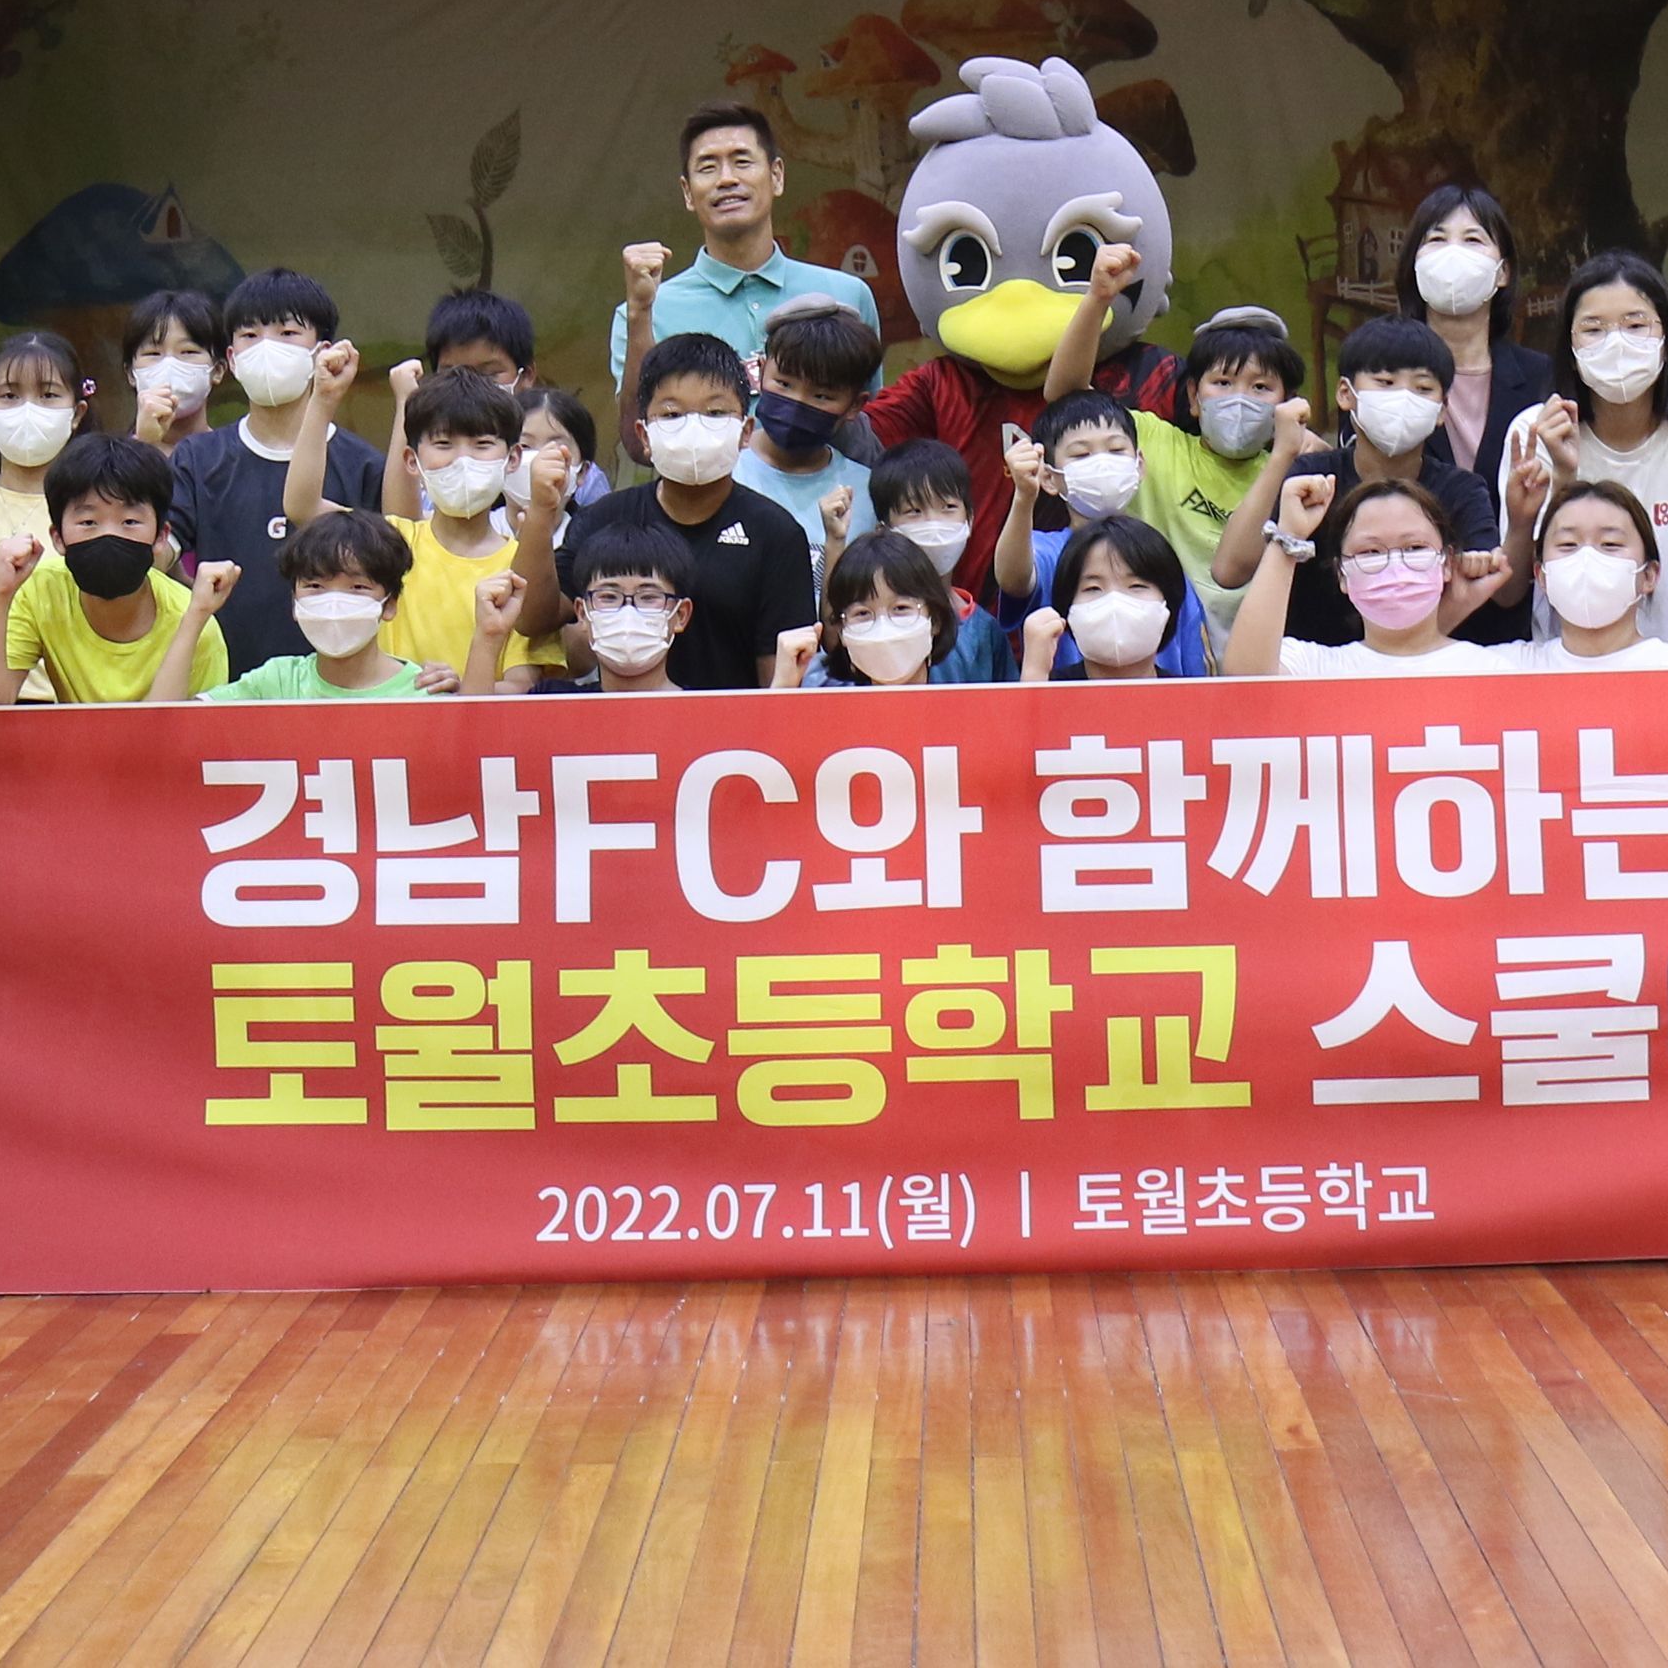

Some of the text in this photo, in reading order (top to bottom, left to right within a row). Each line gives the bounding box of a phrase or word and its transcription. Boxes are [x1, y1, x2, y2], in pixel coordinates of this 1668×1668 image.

[267, 516, 287, 539] G
[198, 745, 985, 929] 경남FC와
[205, 943, 1252, 1132] 토월초등학교
[535, 1162, 1436, 1250] 2022.07.11(월) 토월초등학교
